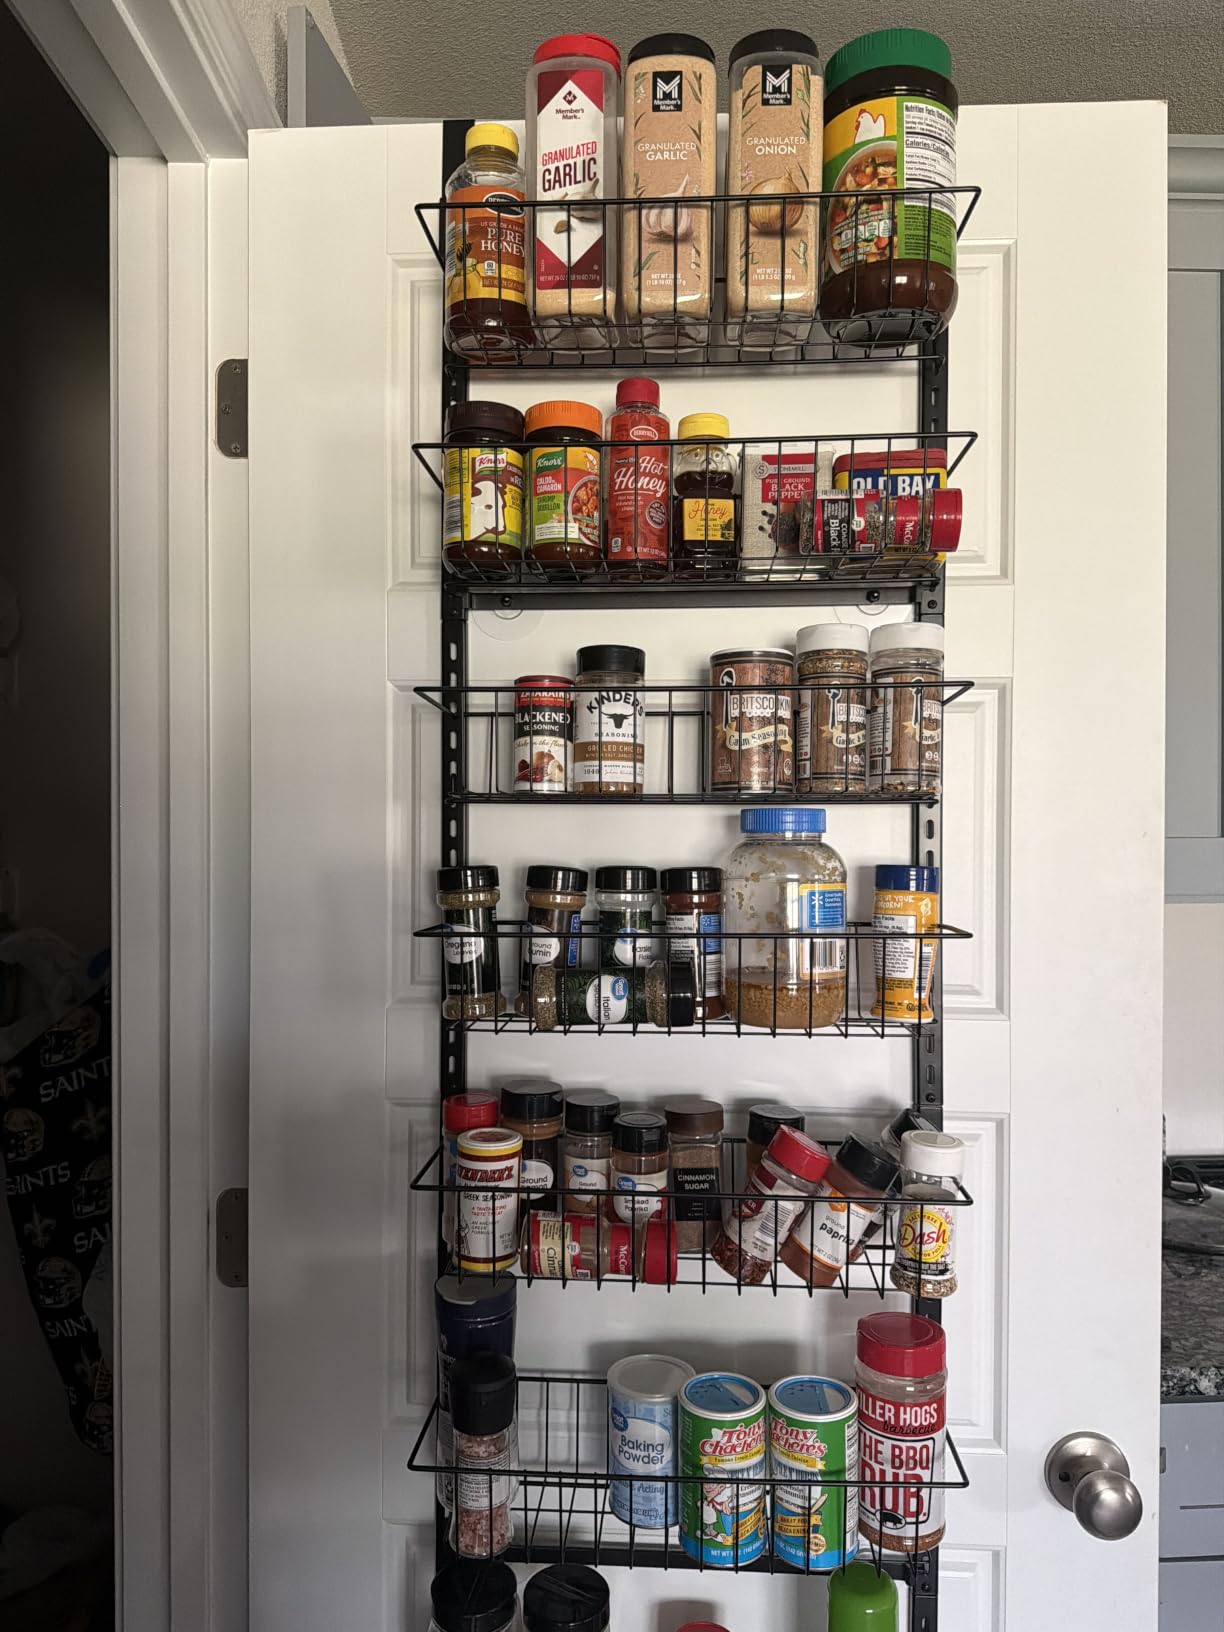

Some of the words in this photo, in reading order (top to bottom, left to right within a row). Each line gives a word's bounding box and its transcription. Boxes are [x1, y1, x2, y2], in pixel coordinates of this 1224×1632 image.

[562, 113, 577, 121] Mark
[637, 142, 697, 151] GRANULATED
[746, 136, 806, 146] GRANULATED
[541, 141, 597, 166] GRANULATED
[646, 151, 688, 161] GARLIC
[755, 145, 797, 155] ONION
[542, 157, 597, 192] GARLIC
[488, 228, 522, 245] PURE
[481, 240, 525, 258] HONEY
[479, 455, 505, 466] Knrr
[537, 457, 562, 468] Knorr
[639, 456, 668, 476] Hot
[614, 467, 666, 497] Honey
[853, 476, 892, 495] OLD
[892, 474, 936, 496] BAY
[688, 500, 728, 520] Hney
[829, 519, 840, 547] Black
[732, 696, 791, 711] BRITSCOKIN
[523, 724, 560, 732] SESONING
[594, 732, 638, 740] SASONIN
[728, 734, 750, 747] Caun
[751, 728, 787, 741] Seasoing
[836, 735, 856, 745] Galic
[588, 744, 617, 752] GRILED
[620, 745, 643, 753] CHICEN
[602, 996, 612, 1021] Italian
[520, 1176, 548, 1184] Ground
[677, 1174, 716, 1182] CINNAMON
[624, 1197, 649, 1205] Smked
[825, 1215, 846, 1230] ground
[819, 1222, 855, 1246] papria
[899, 1222, 948, 1248] Dash
[900, 1403, 938, 1428] HOGS
[772, 1420, 817, 1441] Tony
[882, 1421, 937, 1435] barbecue
[620, 1434, 665, 1456] Baking
[618, 1445, 665, 1465] Powder
[890, 1443, 930, 1472] BBQ
